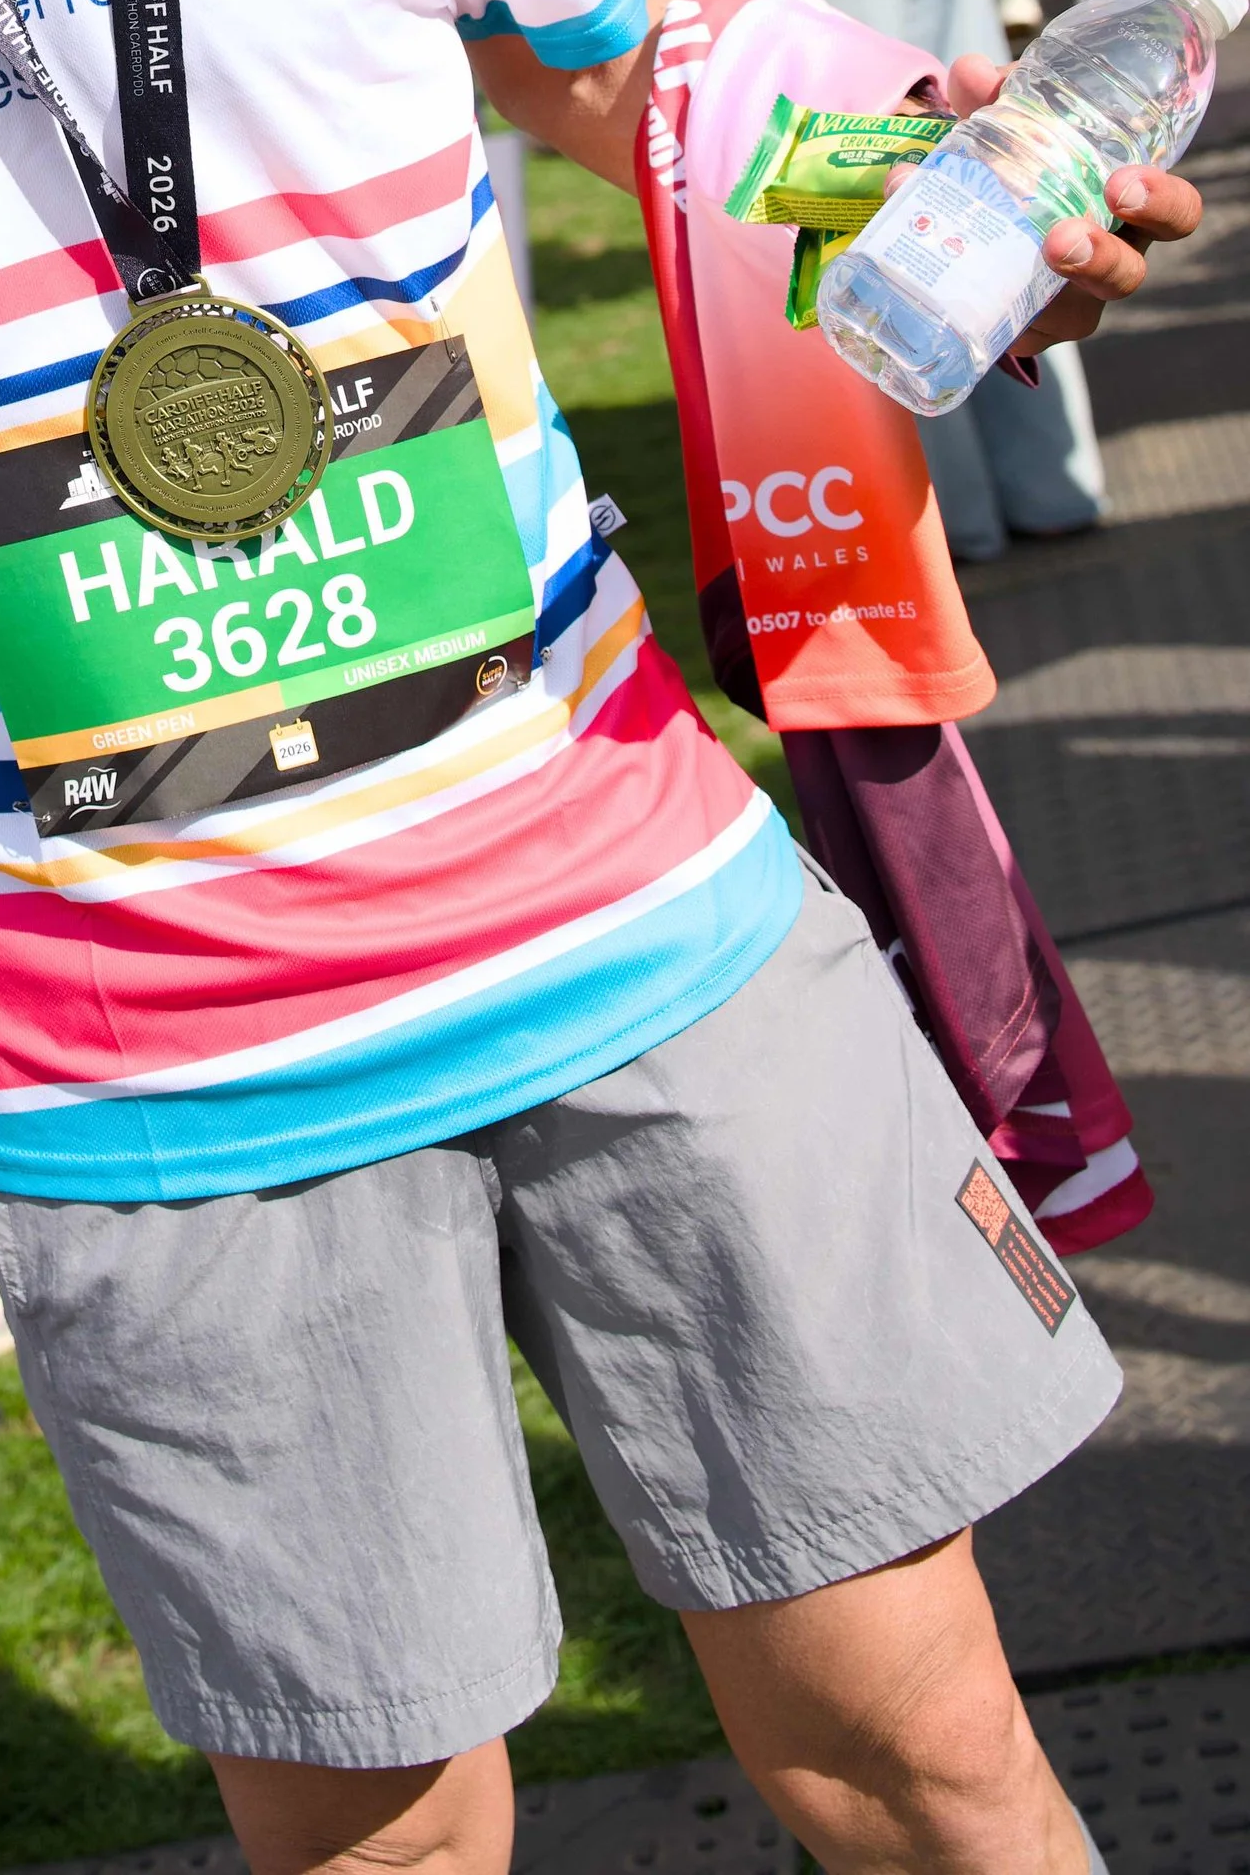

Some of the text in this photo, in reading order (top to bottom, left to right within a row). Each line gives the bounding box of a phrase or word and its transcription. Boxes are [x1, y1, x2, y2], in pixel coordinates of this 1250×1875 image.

[1117, 27, 1137, 42] SEP
[128, 31, 144, 97] CAERDYDD
[145, 24, 172, 95] HALF
[808, 113, 949, 139] NATURE VALLEY
[839, 135, 901, 150] CRUNCHY
[146, 154, 178, 233] 2026
[57, 467, 417, 624] HARALD
[765, 546, 870, 573] WALES
[153, 573, 378, 694] 3628
[746, 601, 917, 636] 0507 to donate £5
[343, 629, 487, 687] UNISEX MEDIUM
[92, 712, 196, 751] GREEN PEN
[279, 740, 312, 759] 2026
[63, 771, 118, 807] R4W
